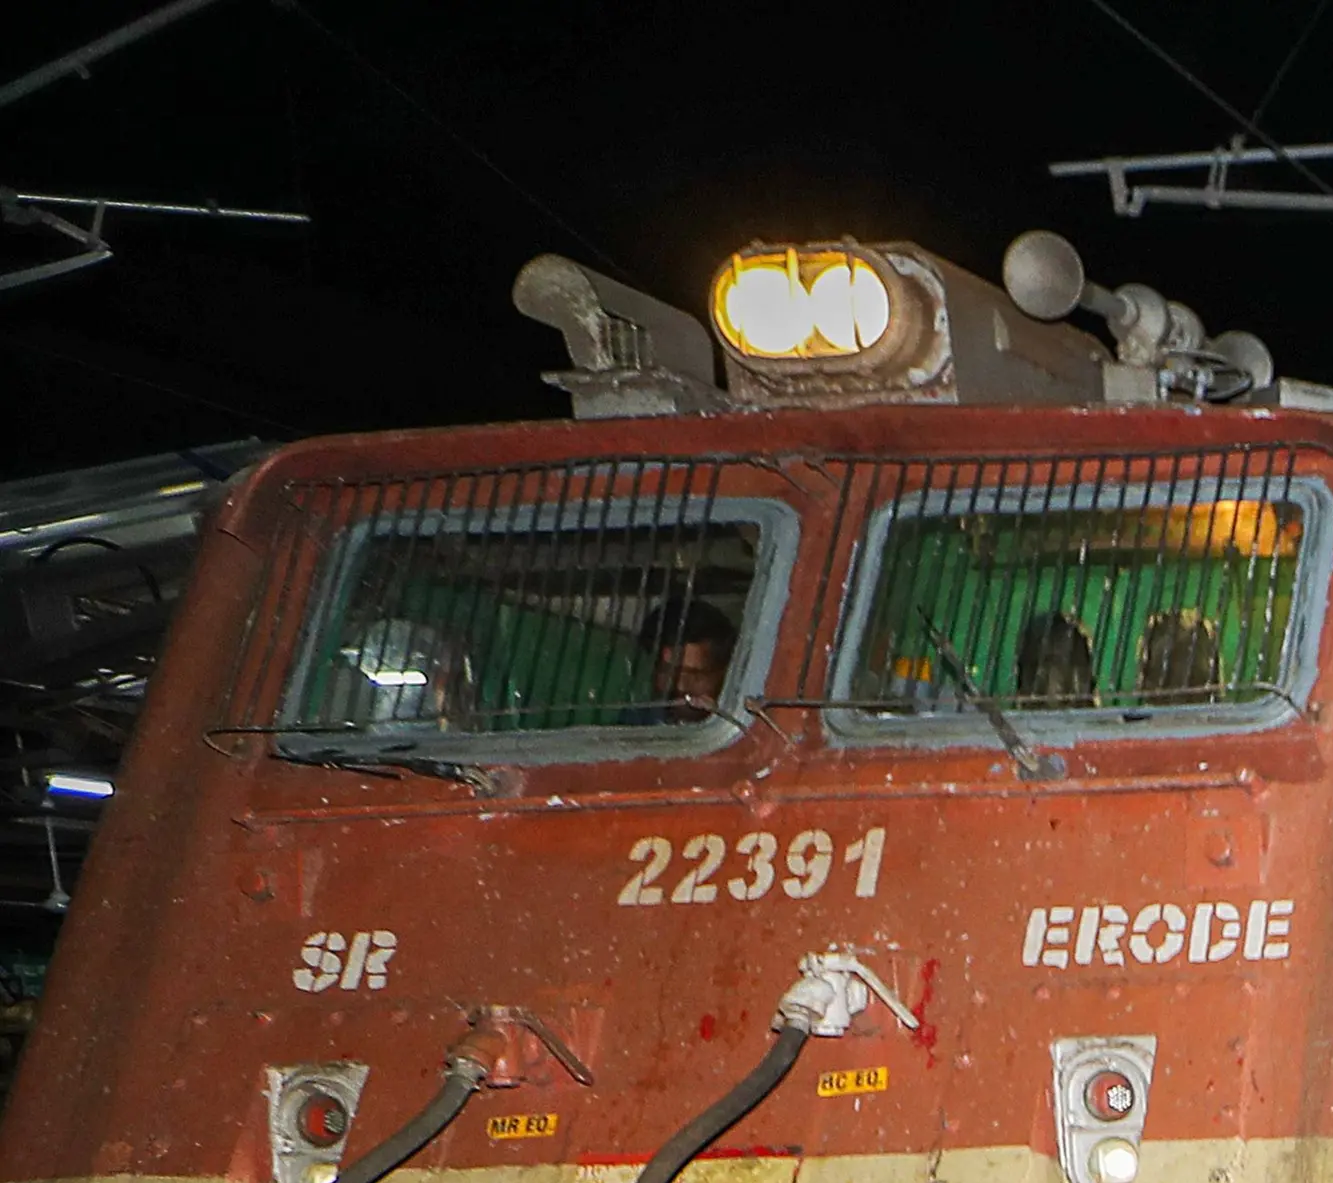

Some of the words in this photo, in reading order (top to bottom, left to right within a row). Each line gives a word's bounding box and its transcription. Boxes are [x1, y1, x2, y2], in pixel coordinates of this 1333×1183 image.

[617, 827, 887, 906] 22391
[292, 930, 397, 993] SR
[1022, 899, 1294, 969] ERODE
